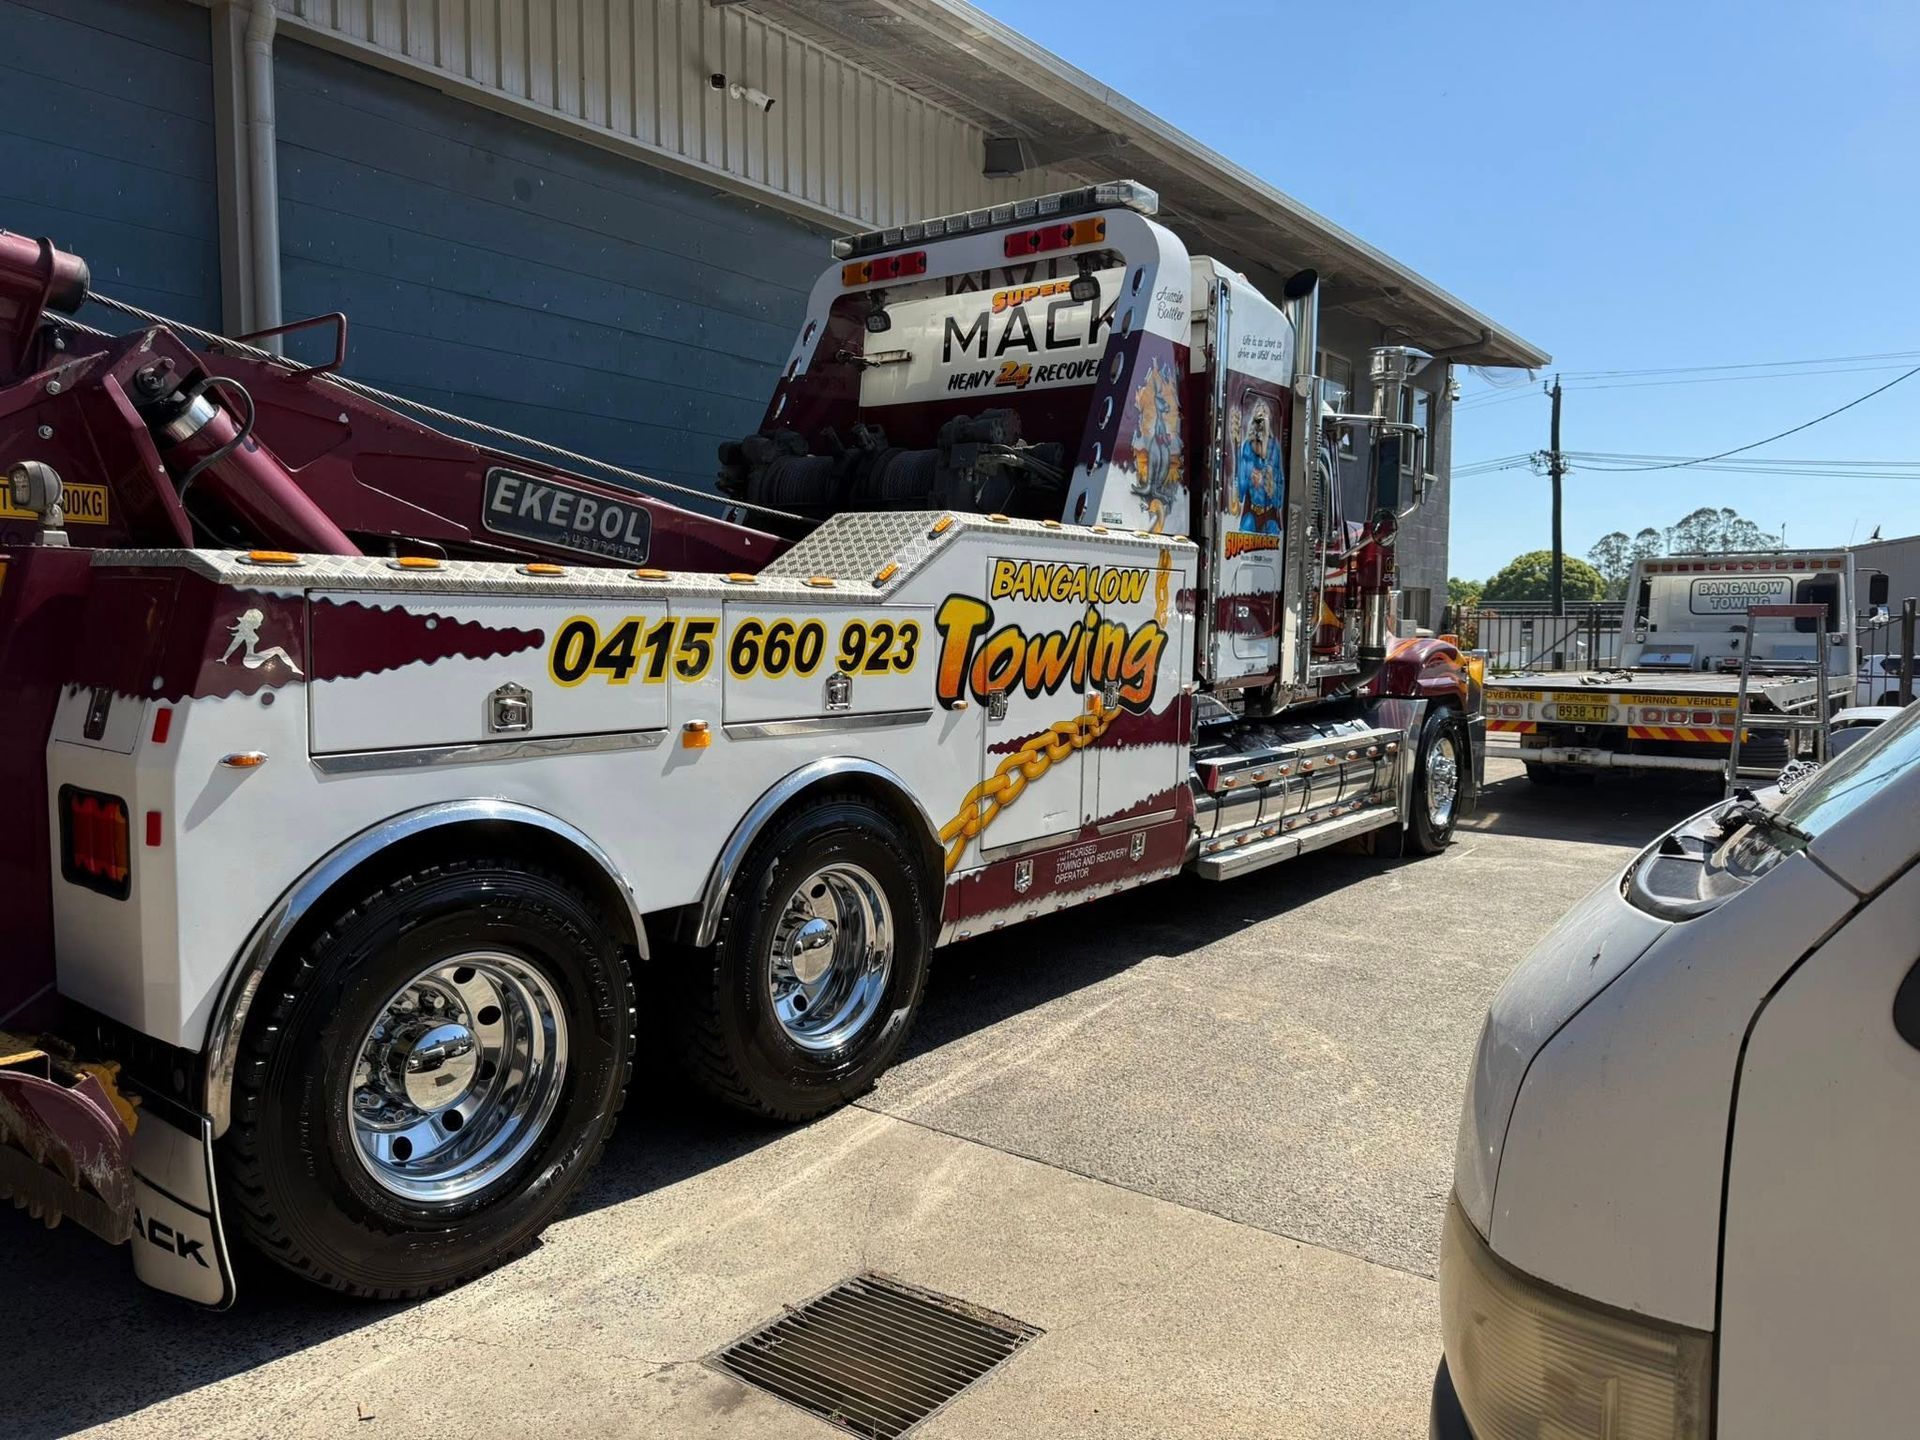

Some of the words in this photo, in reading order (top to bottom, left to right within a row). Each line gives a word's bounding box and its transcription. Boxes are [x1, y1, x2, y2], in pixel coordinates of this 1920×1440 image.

[992, 280, 1071, 314] SUPER
[942, 296, 1116, 363] MACK
[948, 369, 995, 391] HEAVY
[994, 360, 1033, 390] 24
[490, 476, 641, 546] EKEBOL
[1225, 531, 1280, 560] SUPERMACK
[990, 559, 1149, 604] BANGALOW
[1699, 581, 1784, 595] BANGALOW
[547, 615, 720, 688] 0415
[726, 617, 828, 680] 660
[835, 617, 922, 677] 923
[935, 593, 1168, 716] Towing
[1631, 695, 1678, 705] TURNING
[1686, 697, 1732, 707] VEHICLE
[1055, 867, 1089, 884] OPERATOR
[1056, 859, 1082, 874] TOWING
[1082, 855, 1096, 868] AND
[1096, 847, 1128, 864] RECOVERY
